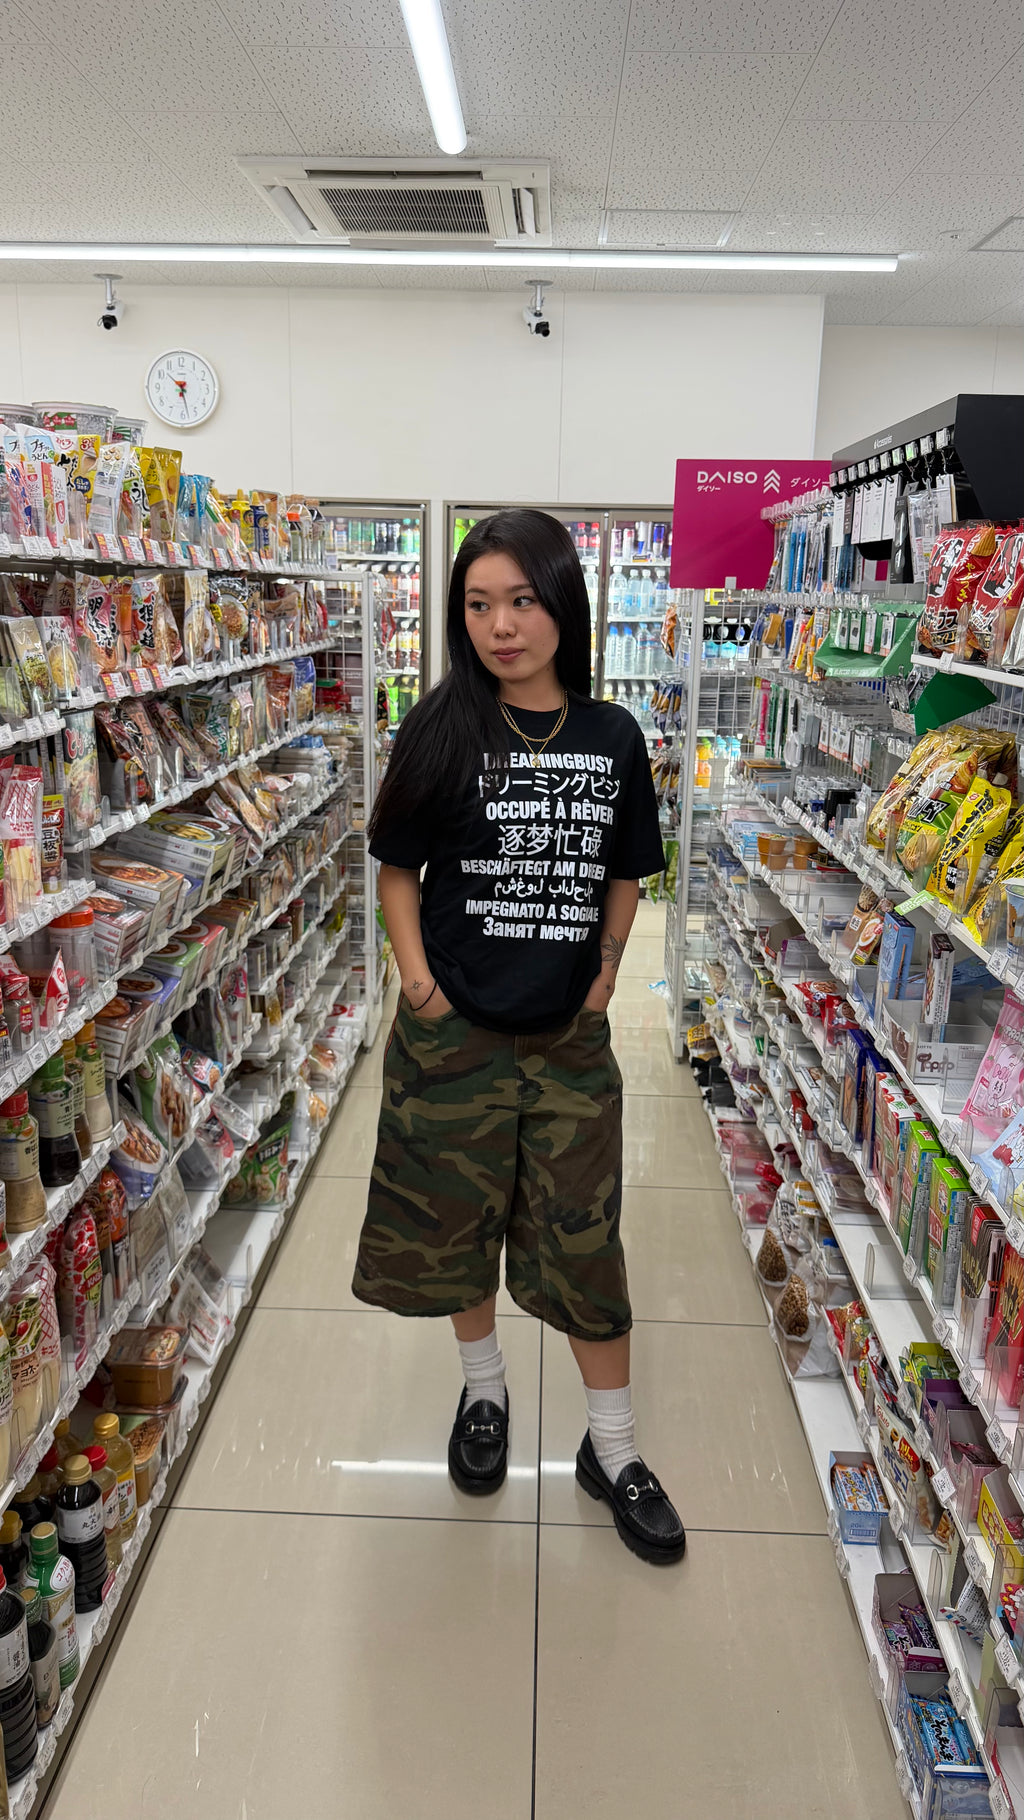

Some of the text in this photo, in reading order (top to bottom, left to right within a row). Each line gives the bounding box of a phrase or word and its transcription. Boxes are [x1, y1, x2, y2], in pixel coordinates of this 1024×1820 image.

[697, 471, 758, 484] DAISO
[697, 485, 721, 493] ダイソー
[486, 797, 614, 826] OCCUPÉ À RÊVER
[498, 822, 603, 858] 逐梦忙碌
[552, 861, 575, 877] AM
[465, 899, 544, 919] IMPEGNATO
[546, 903, 557, 920] A
[482, 917, 536, 939] Занят
[916, 1052, 955, 1074] Toppo
[876, 1404, 890, 1428] Tohato
